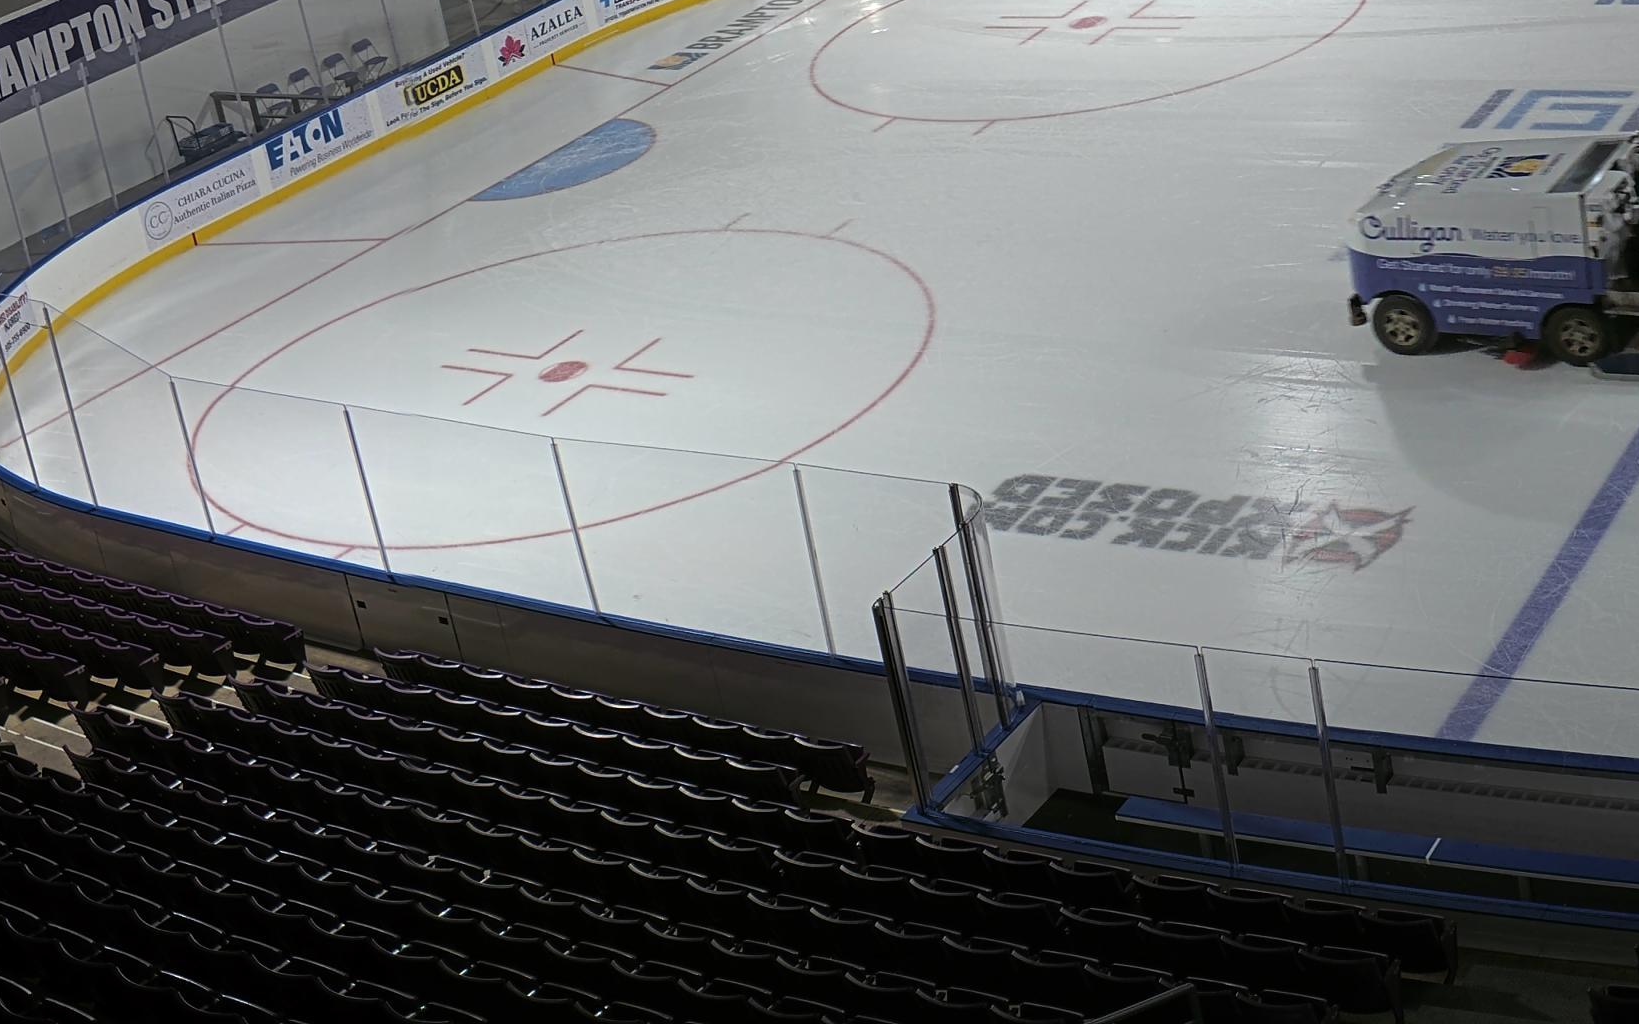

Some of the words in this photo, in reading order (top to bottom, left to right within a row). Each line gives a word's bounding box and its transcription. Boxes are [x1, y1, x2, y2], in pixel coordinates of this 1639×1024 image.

[530, 5, 583, 41] AZALEA
[415, 67, 462, 102] UCDA
[265, 108, 345, 171] EATON
[173, 201, 211, 225] Authentic
[211, 188, 236, 207] Italian
[236, 178, 256, 196] Pizza
[177, 185, 212, 208] CHIARA
[212, 169, 246, 194] CUCINA
[1360, 215, 1464, 253] Culligan
